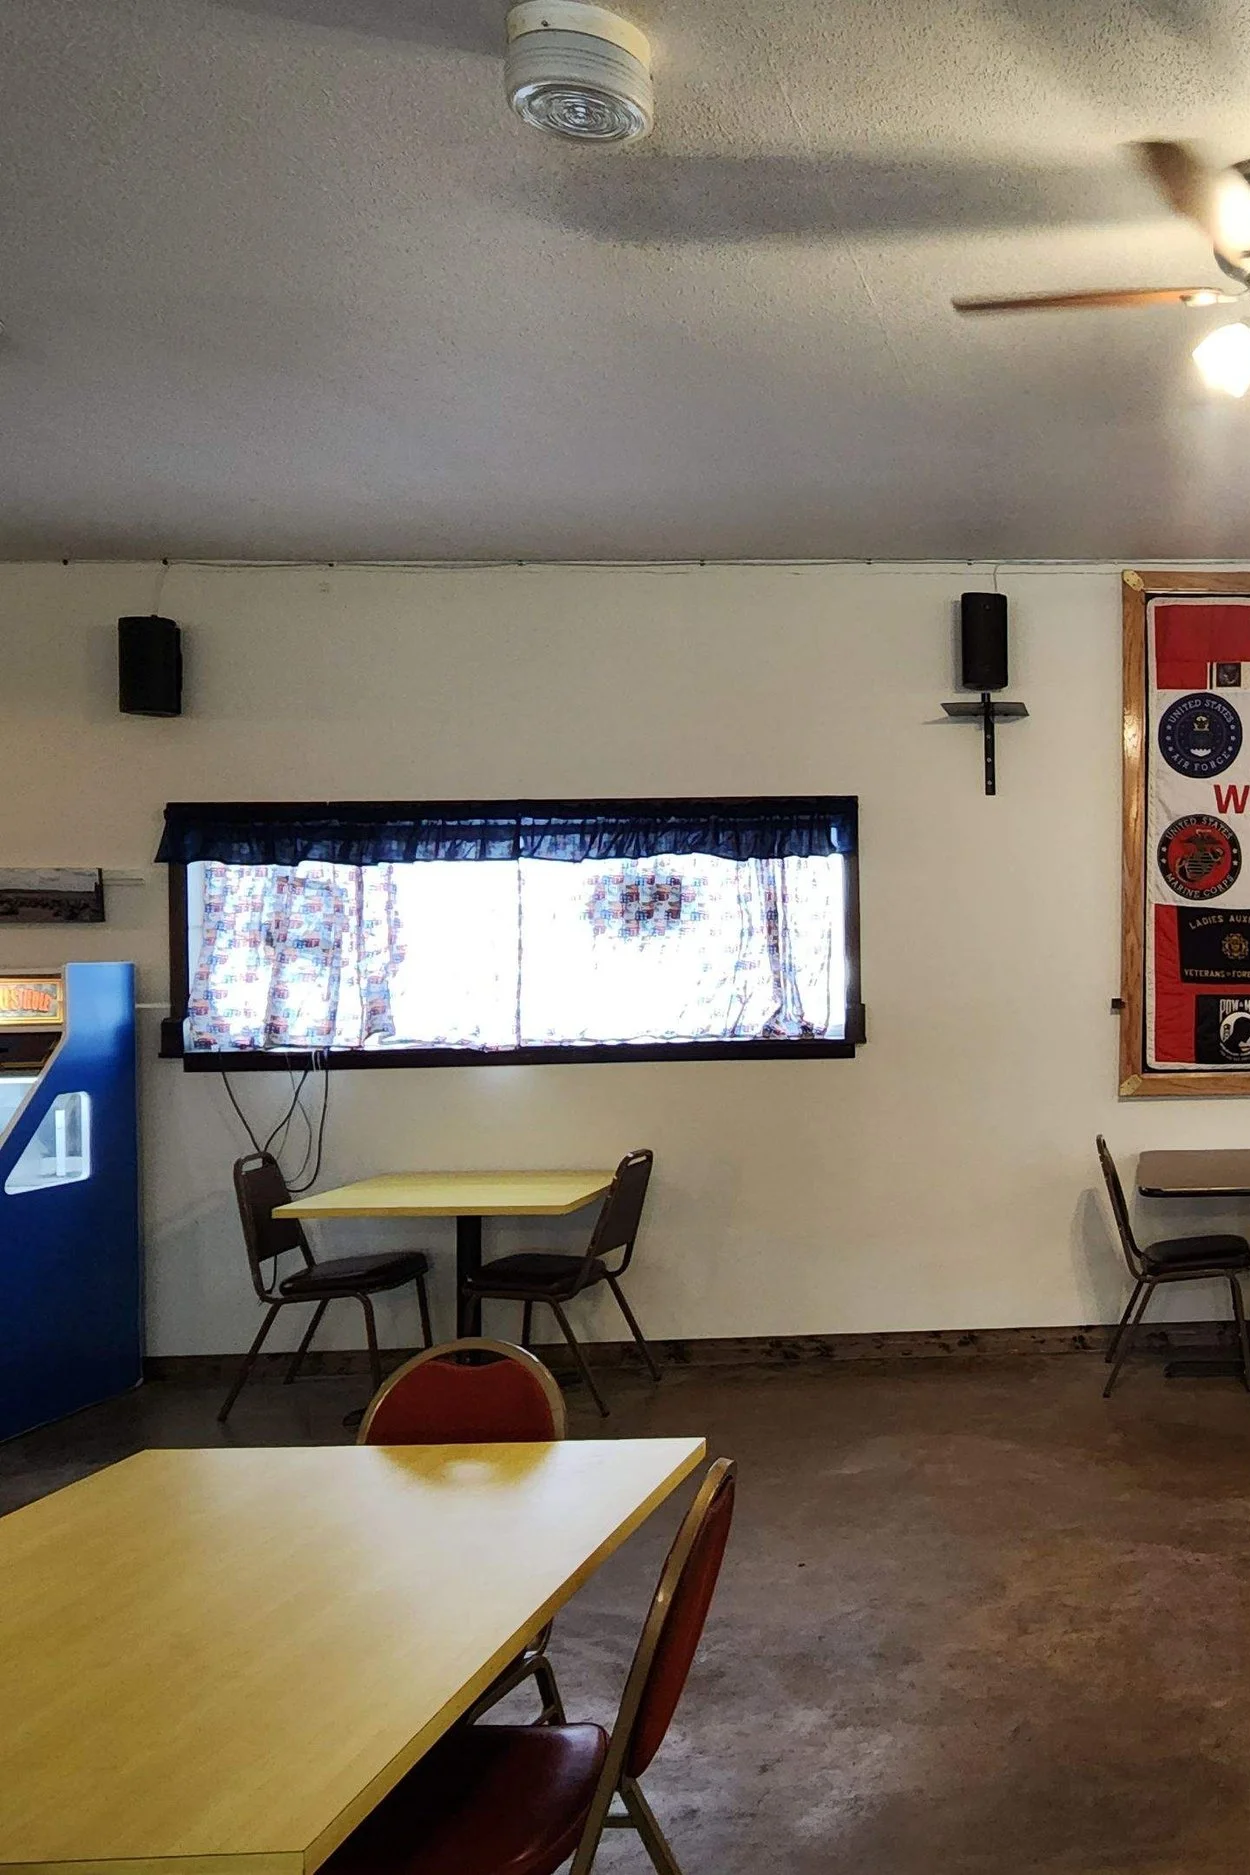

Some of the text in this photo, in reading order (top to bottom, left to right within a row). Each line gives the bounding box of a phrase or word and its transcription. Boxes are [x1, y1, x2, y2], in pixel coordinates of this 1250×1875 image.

[1168, 699, 1234, 723] UNITED STATES
[1171, 751, 1231, 771] AIR FORCE
[1165, 816, 1233, 840] UNITED STATES
[1166, 873, 1234, 898] MARINE CORPS
[1188, 914, 1224, 930] LADIES
[1184, 968, 1225, 978] VETERANS
[1219, 998, 1240, 1021] POW
